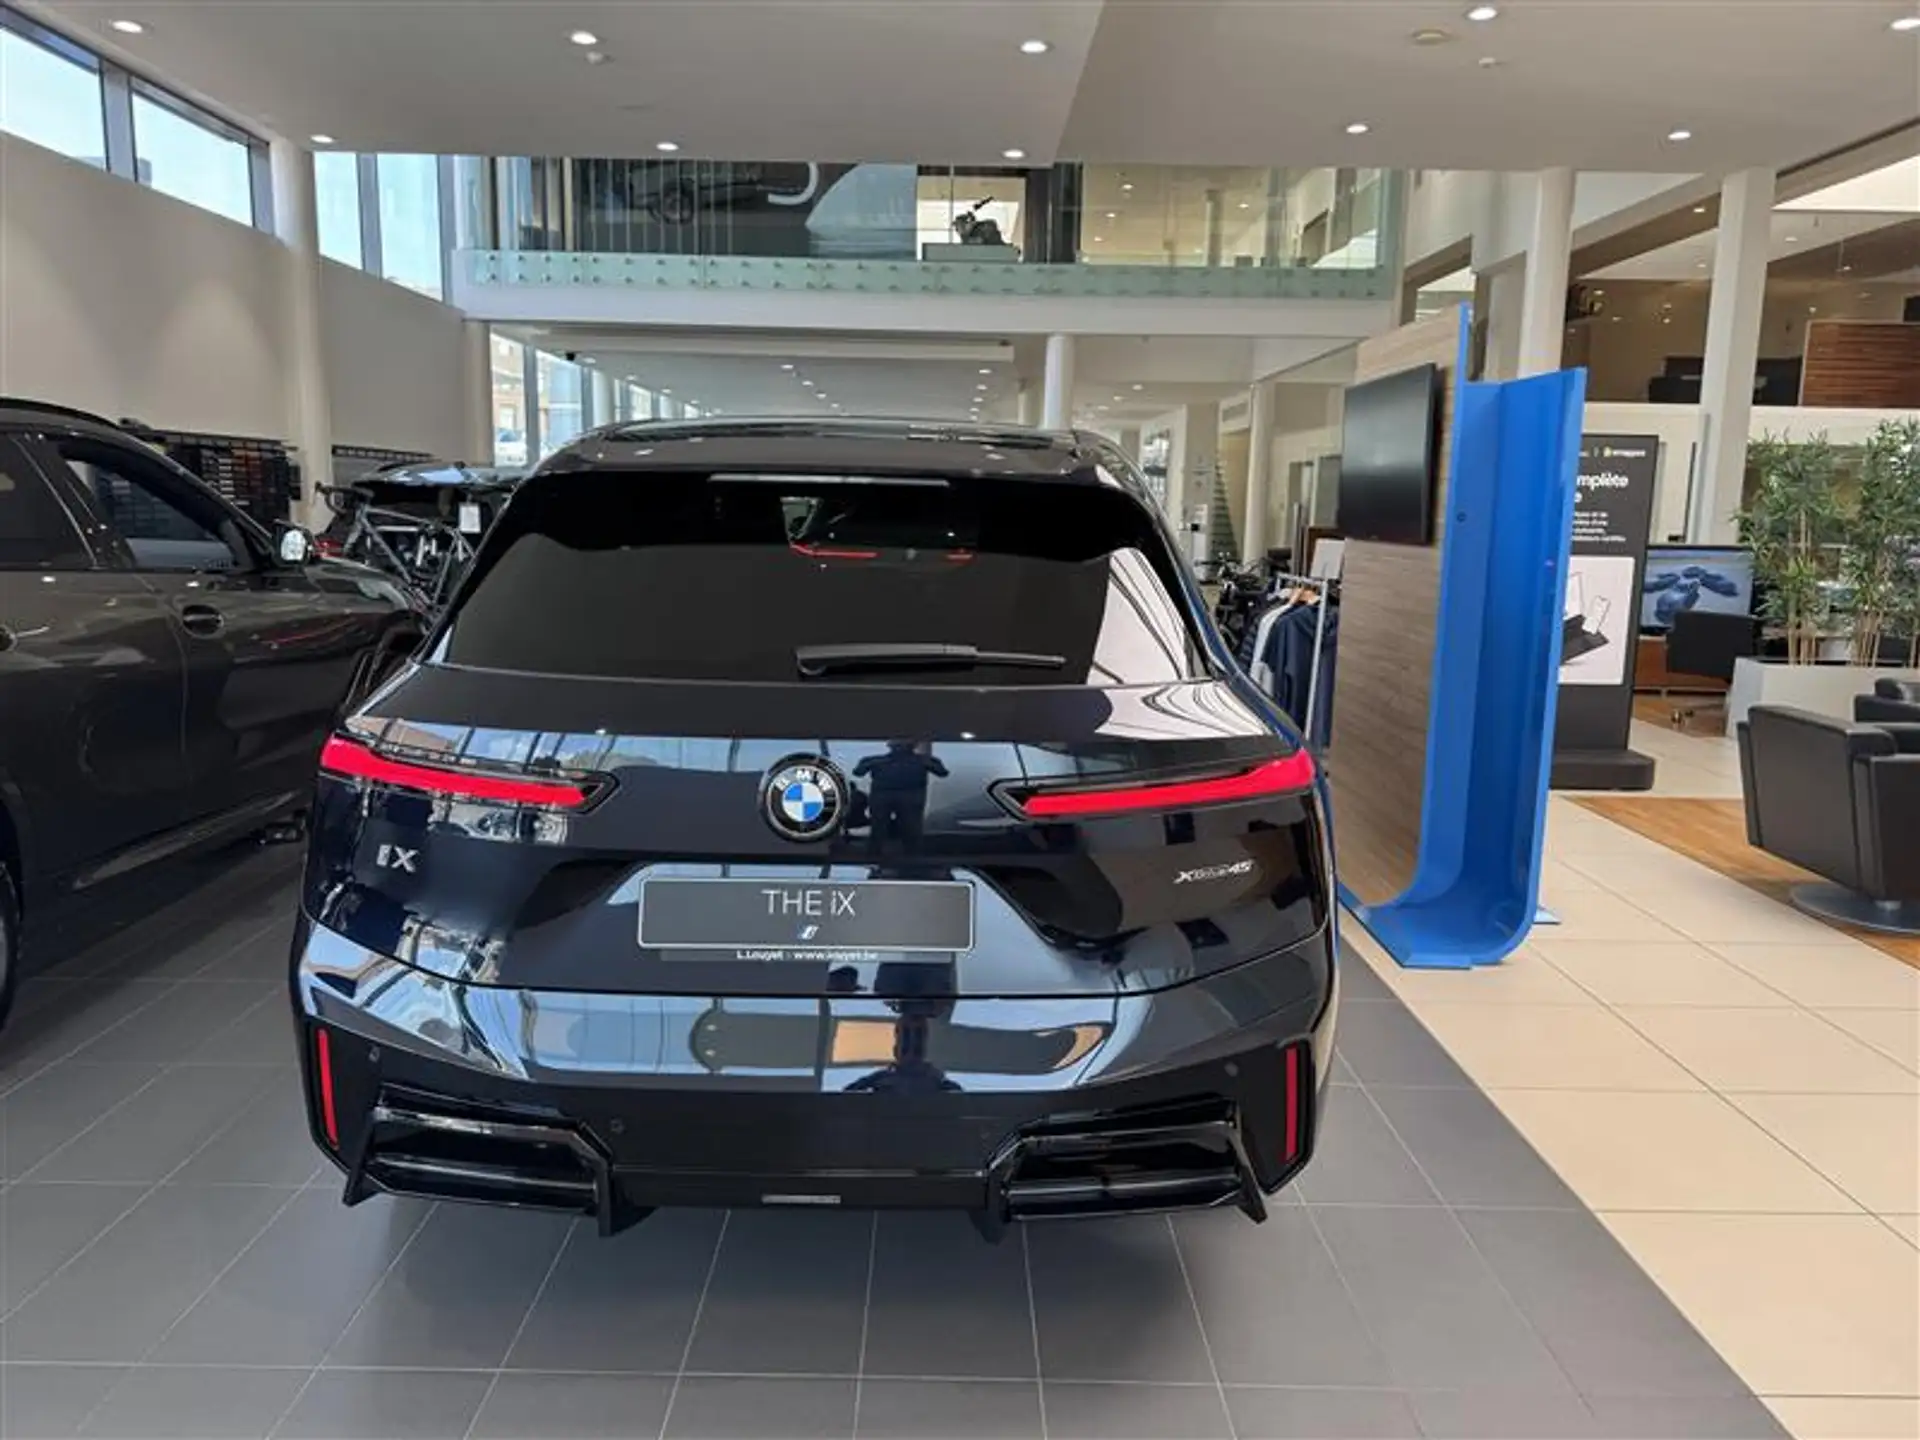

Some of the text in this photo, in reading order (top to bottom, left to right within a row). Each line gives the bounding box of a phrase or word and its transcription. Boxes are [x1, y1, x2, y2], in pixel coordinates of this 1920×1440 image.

[775, 768, 832, 792] BMW
[761, 889, 856, 916] THE iX
